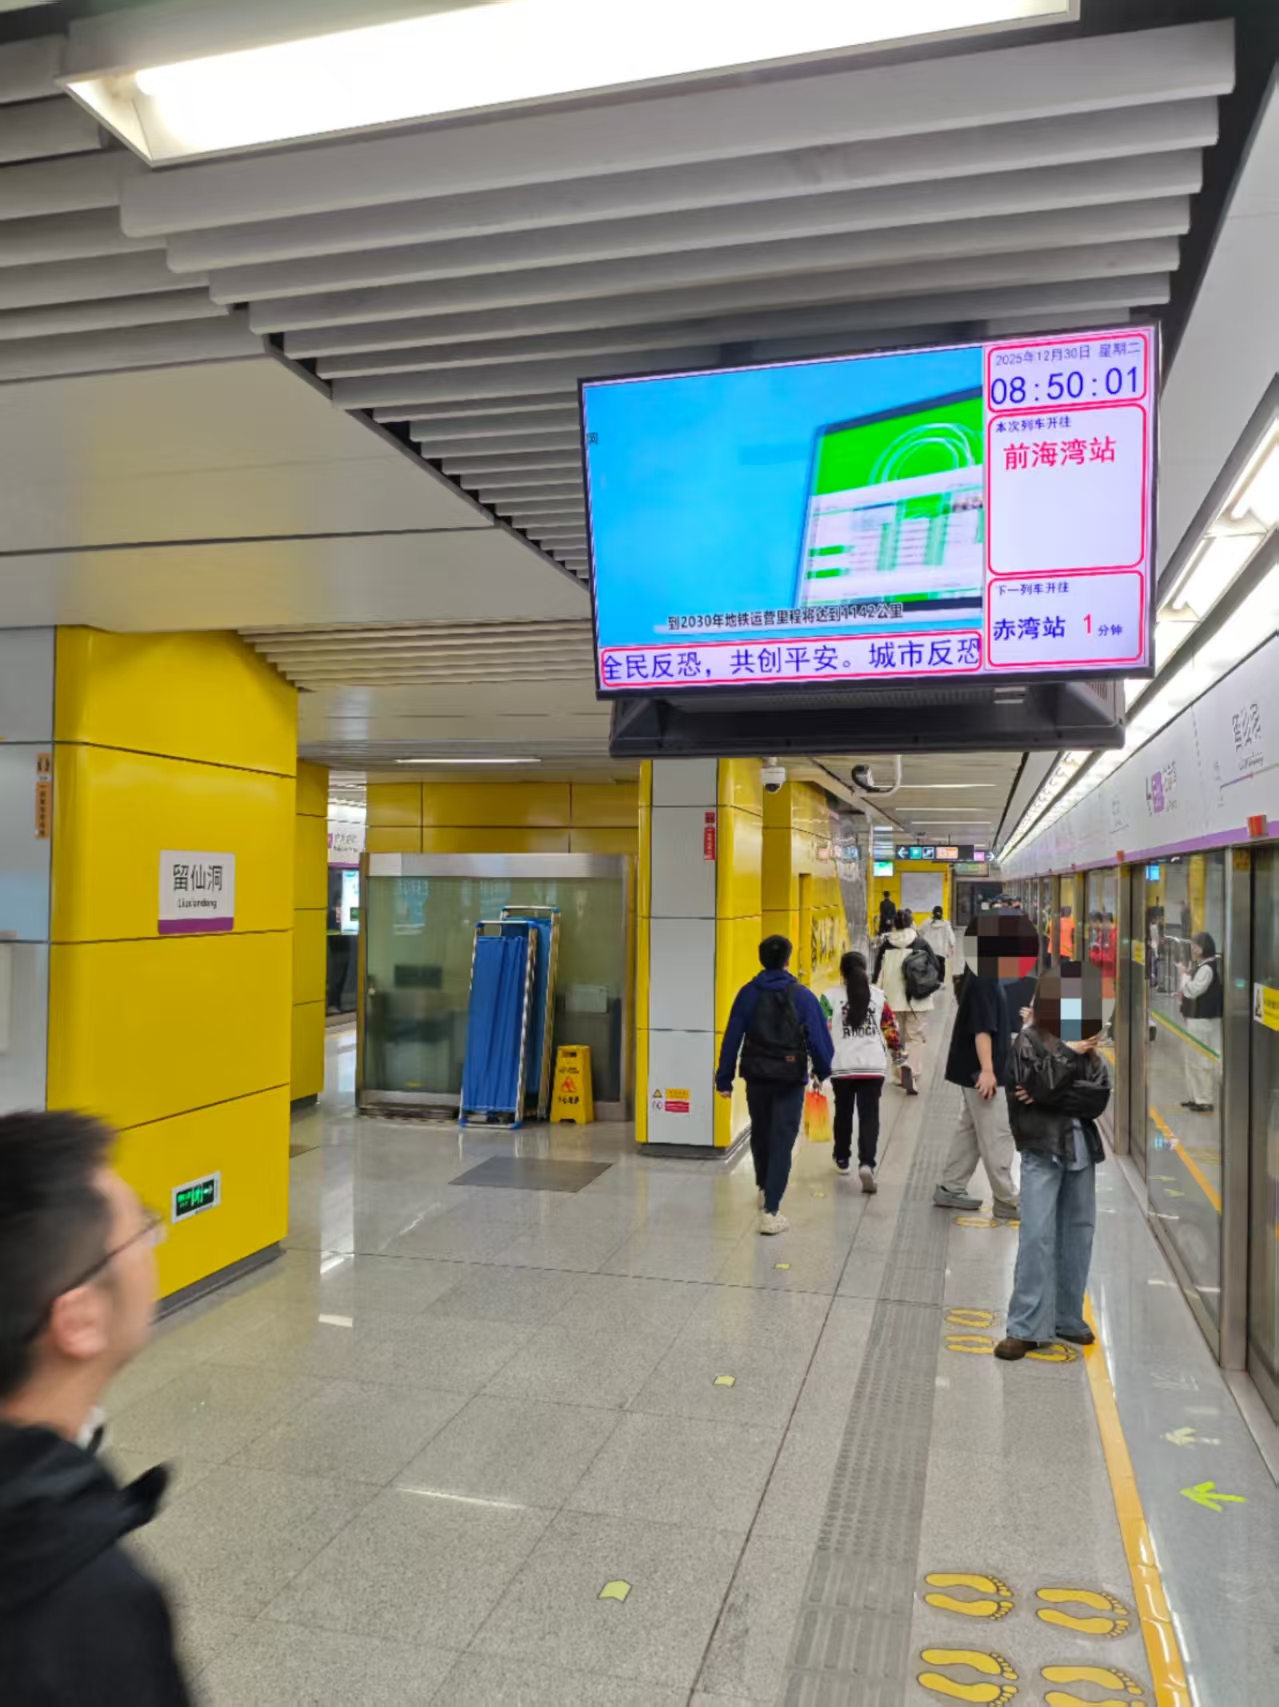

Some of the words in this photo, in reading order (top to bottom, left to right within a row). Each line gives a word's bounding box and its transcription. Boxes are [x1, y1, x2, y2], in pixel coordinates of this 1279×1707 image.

[995, 344, 1091, 366] 2025年12月30日
[1098, 341, 1141, 358] 星期二
[990, 366, 1138, 405] 08:50:01
[995, 415, 1072, 433] 本次列车开往
[1003, 435, 1117, 471] 前海湾站
[998, 581, 1070, 596] 下一列车开往
[993, 615, 1066, 641] 赤湾站
[1083, 613, 1092, 635] 1
[1098, 624, 1123, 637] 分钟
[173, 864, 223, 892] 留仙洞
